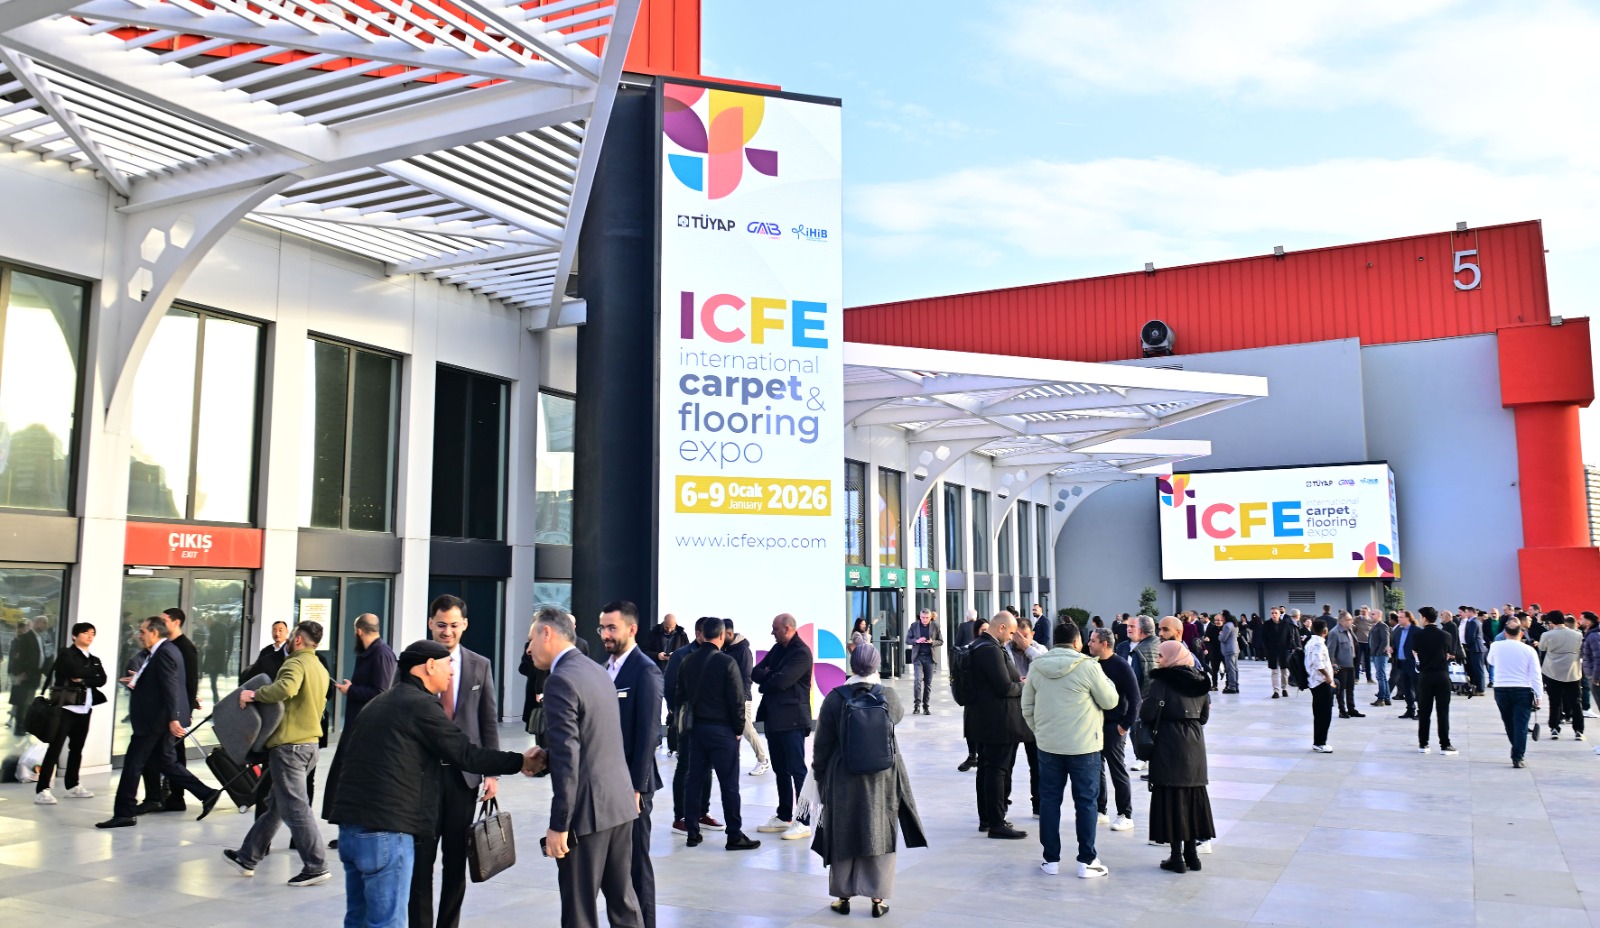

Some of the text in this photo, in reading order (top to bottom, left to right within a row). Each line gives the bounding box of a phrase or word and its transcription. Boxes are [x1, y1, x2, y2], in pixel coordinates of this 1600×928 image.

[691, 214, 736, 232] TÜYAP
[1453, 249, 1482, 291] 5
[680, 290, 829, 350] ICFE
[680, 346, 819, 374] international
[679, 373, 826, 412] carpet &
[678, 401, 819, 444] flooring
[679, 439, 763, 470] expo
[728, 482, 763, 498] Ocak
[767, 484, 828, 510] 2026
[728, 499, 763, 512] January
[1306, 506, 1351, 517] carpet
[1306, 517, 1357, 528] flooring
[1307, 528, 1338, 538] expo
[168, 532, 213, 553] ÇIKIŞ
[675, 533, 827, 550] www.icfexpo.com
[181, 550, 199, 559] EXIT
